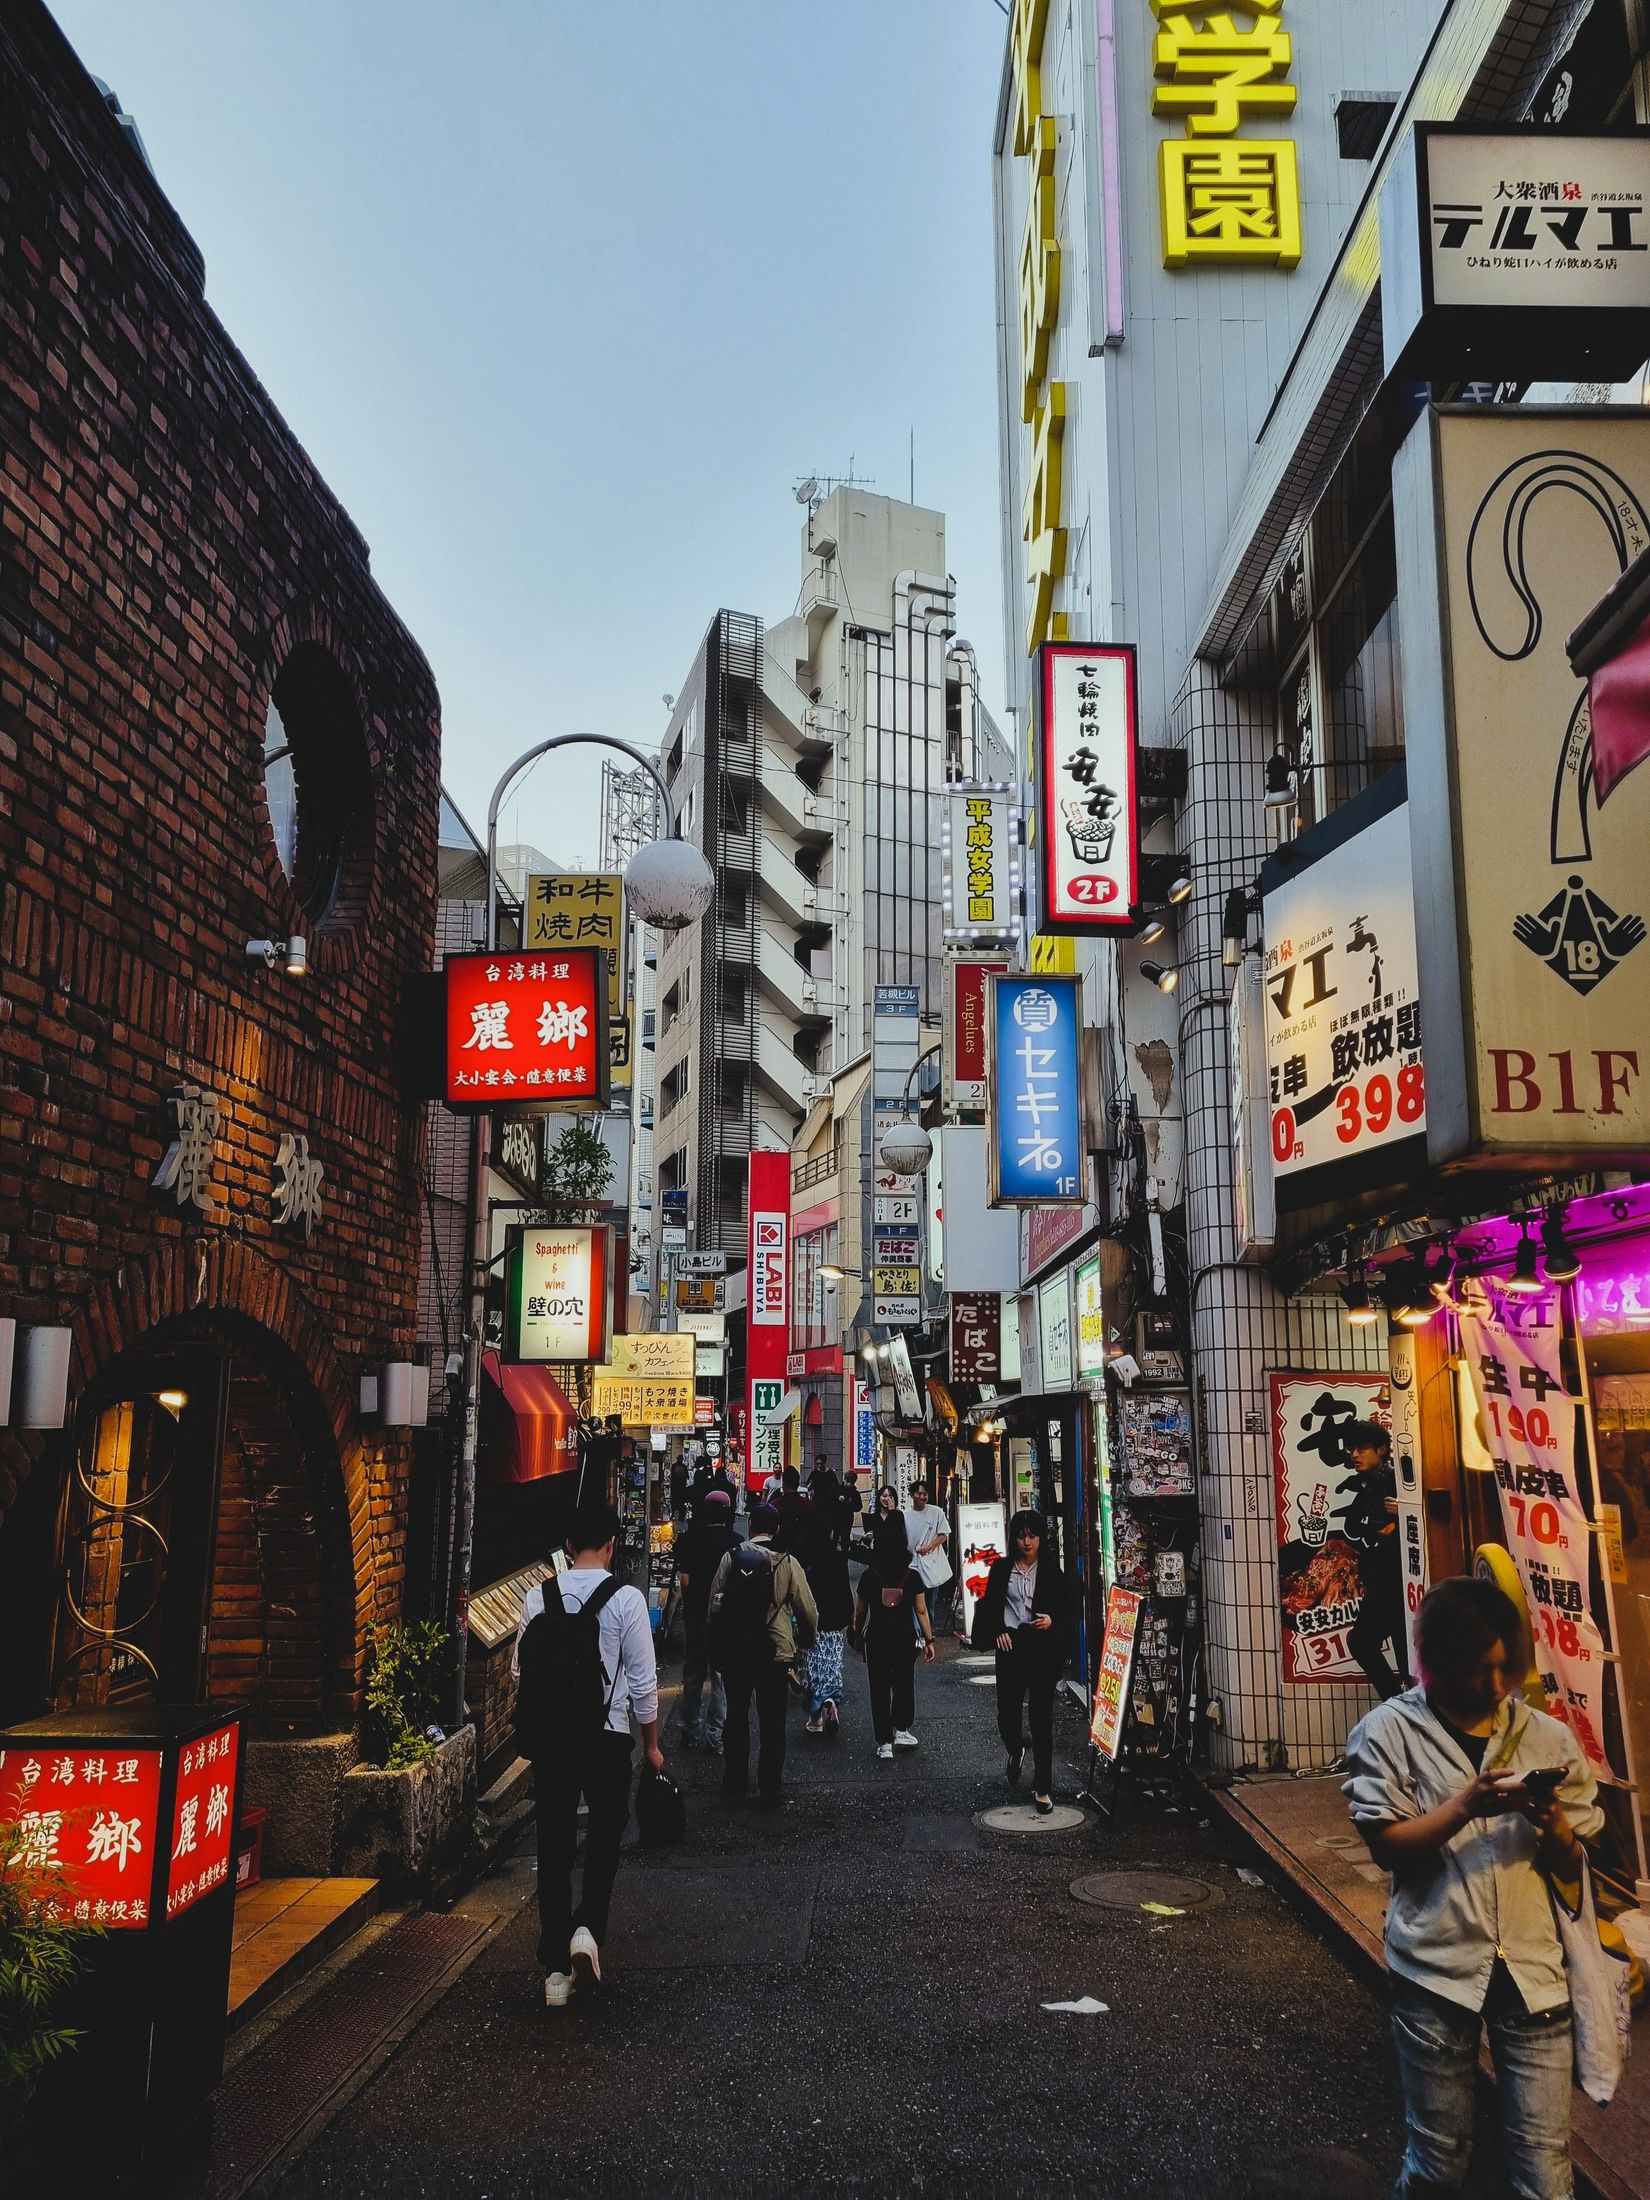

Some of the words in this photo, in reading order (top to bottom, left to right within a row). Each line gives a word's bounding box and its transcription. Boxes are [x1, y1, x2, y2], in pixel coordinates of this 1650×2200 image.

[1433, 203, 1648, 251] テルマエ
[1075, 664, 1101, 738] 七輪焼肉
[1062, 746, 1119, 820] 安安
[966, 798, 994, 922] 平成女学園
[536, 878, 615, 905] 和牛
[1076, 879, 1111, 901] 2F
[534, 911, 613, 941] 焼肉
[1564, 940, 1600, 973] 18
[485, 962, 570, 983] 台湾料理
[878, 989, 916, 1000] 若槻ビル
[962, 992, 979, 1054] Angelues
[1015, 989, 1055, 1031] 質
[460, 1000, 588, 1051] 麗郷
[970, 1083, 986, 1098] 2
[1487, 1049, 1640, 1115] B1F
[1015, 1036, 1064, 1173] セキネ
[1336, 1062, 1426, 1144] 398
[1056, 1176, 1076, 1195] 1F
[893, 1201, 913, 1218] 2F
[536, 1242, 579, 1258] Spaghetti
[878, 1240, 916, 1254] たばこ
[681, 1257, 722, 1268] 小島ビル
[877, 1270, 909, 1280] やきとり
[545, 1278, 566, 1291] wine
[756, 1252, 764, 1314] SHIBUYA
[766, 1253, 783, 1311] LABI
[528, 1297, 583, 1317] 壁の穴
[631, 1341, 673, 1355] すっぴん
[955, 1303, 998, 1372] たばこ
[644, 1357, 691, 1368] カフェバー
[1143, 1368, 1163, 1377] 1992
[645, 1387, 688, 1397] もつ焼き
[1478, 1354, 1563, 1402] 生中
[619, 1401, 632, 1410] 99
[645, 1398, 688, 1408] 大衆酒場
[653, 1411, 680, 1420] 次世代
[755, 1413, 768, 1468] センター
[1509, 1496, 1569, 1551] 70円
[1406, 1514, 1420, 1576] 座席
[183, 1732, 229, 1777] 台湾料理
[22, 1756, 139, 1787] 台湾料理
[172, 1783, 229, 1861] 麗郷
